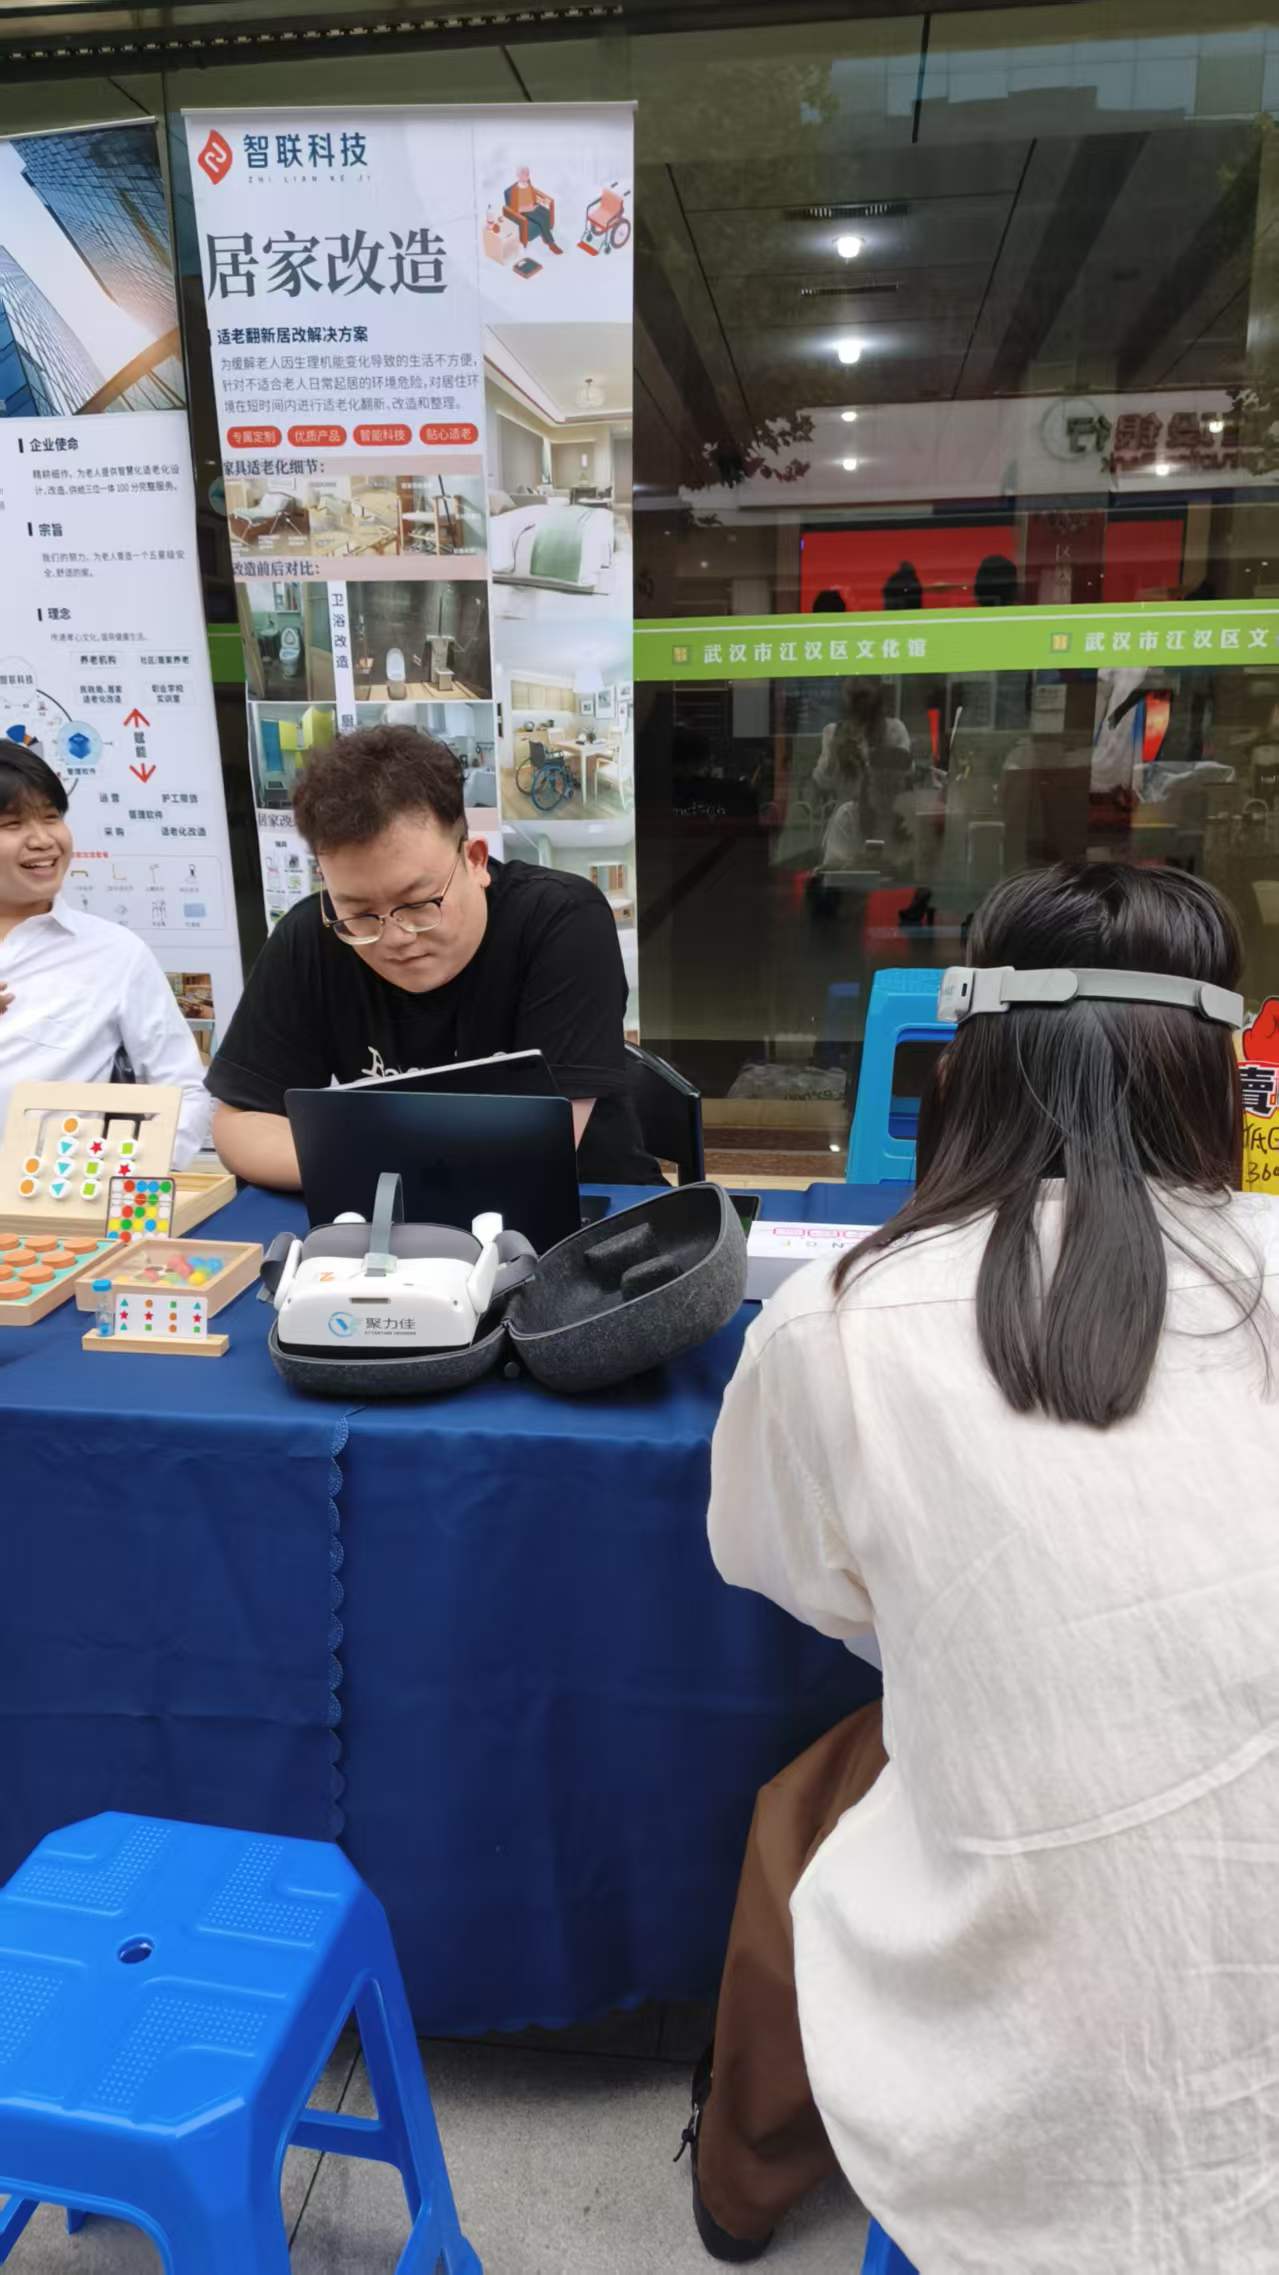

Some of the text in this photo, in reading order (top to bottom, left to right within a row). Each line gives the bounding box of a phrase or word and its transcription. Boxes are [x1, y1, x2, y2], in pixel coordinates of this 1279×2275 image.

[243, 133, 368, 168] 智联科技
[206, 228, 447, 299] 居家改造
[216, 326, 368, 345] 适老翻新居改解决方案
[294, 427, 341, 443] 优质产品
[360, 427, 406, 442] 智能科技
[30, 437, 78, 452] 企业使命
[38, 523, 63, 537] 宗旨
[48, 608, 71, 620] 理念
[331, 593, 349, 669] 卫浴改造
[1085, 628, 1279, 652] 武汉市江汉区文
[704, 639, 927, 664] 武汉市江汉区文化馆
[366, 1317, 416, 1331] 聚力佳
